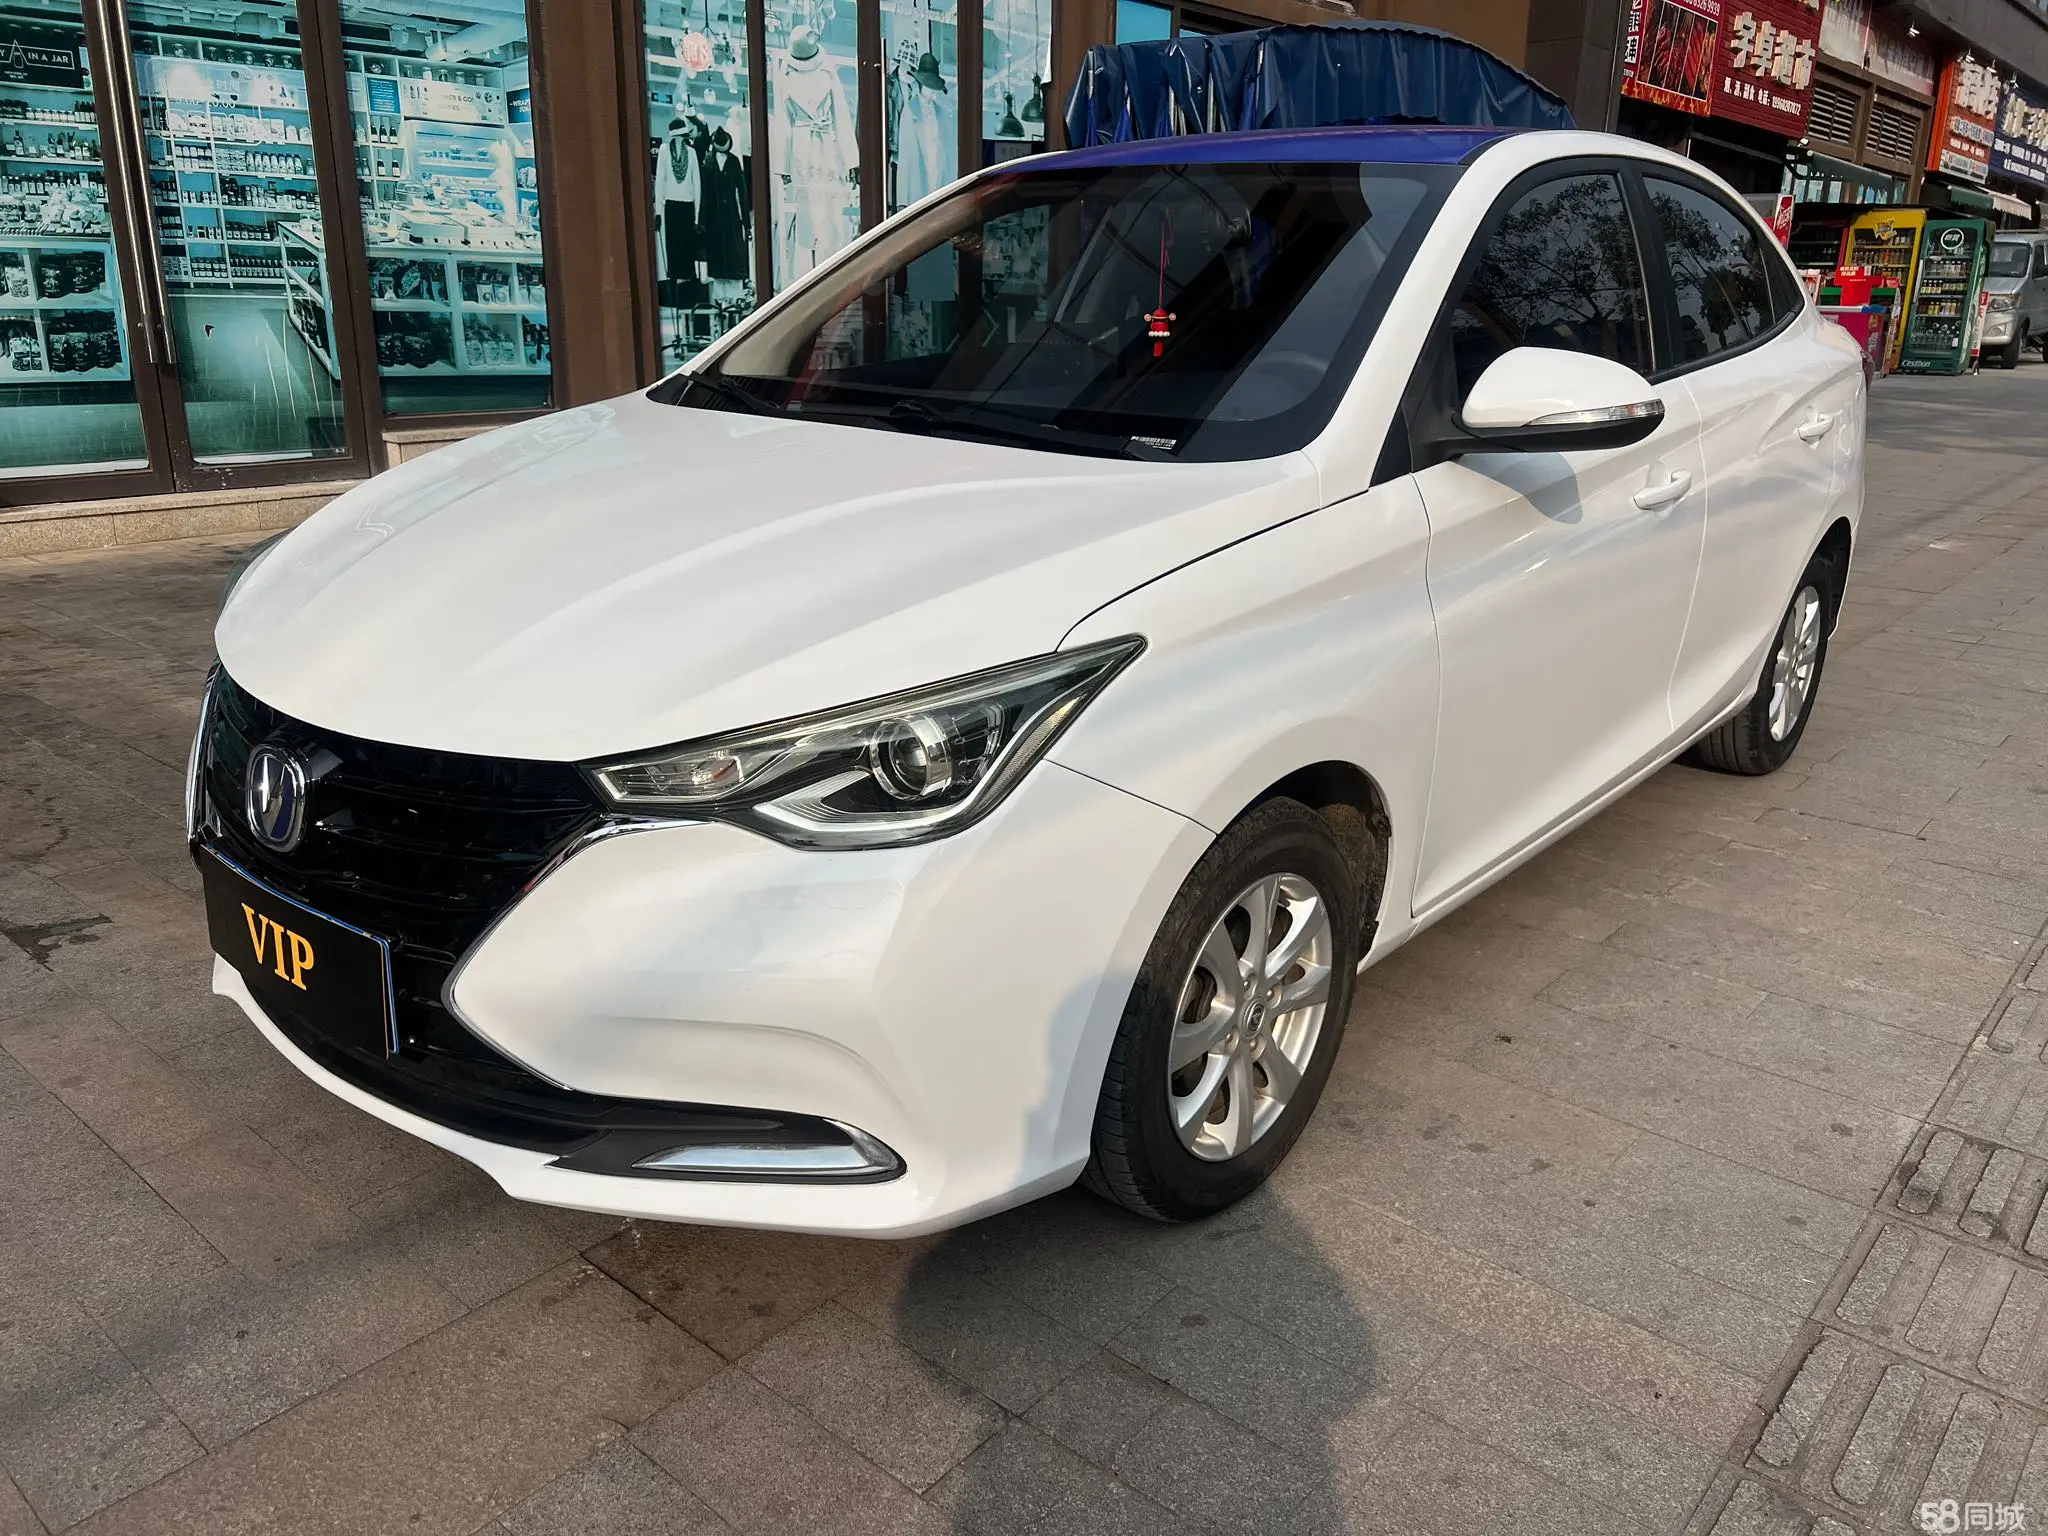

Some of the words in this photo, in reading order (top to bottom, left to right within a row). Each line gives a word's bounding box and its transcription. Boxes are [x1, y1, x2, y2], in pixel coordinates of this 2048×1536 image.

[28, 52, 39, 60] IN
[41, 53, 48, 61] A
[51, 55, 69, 63] JAR
[241, 902, 314, 991] VIP
